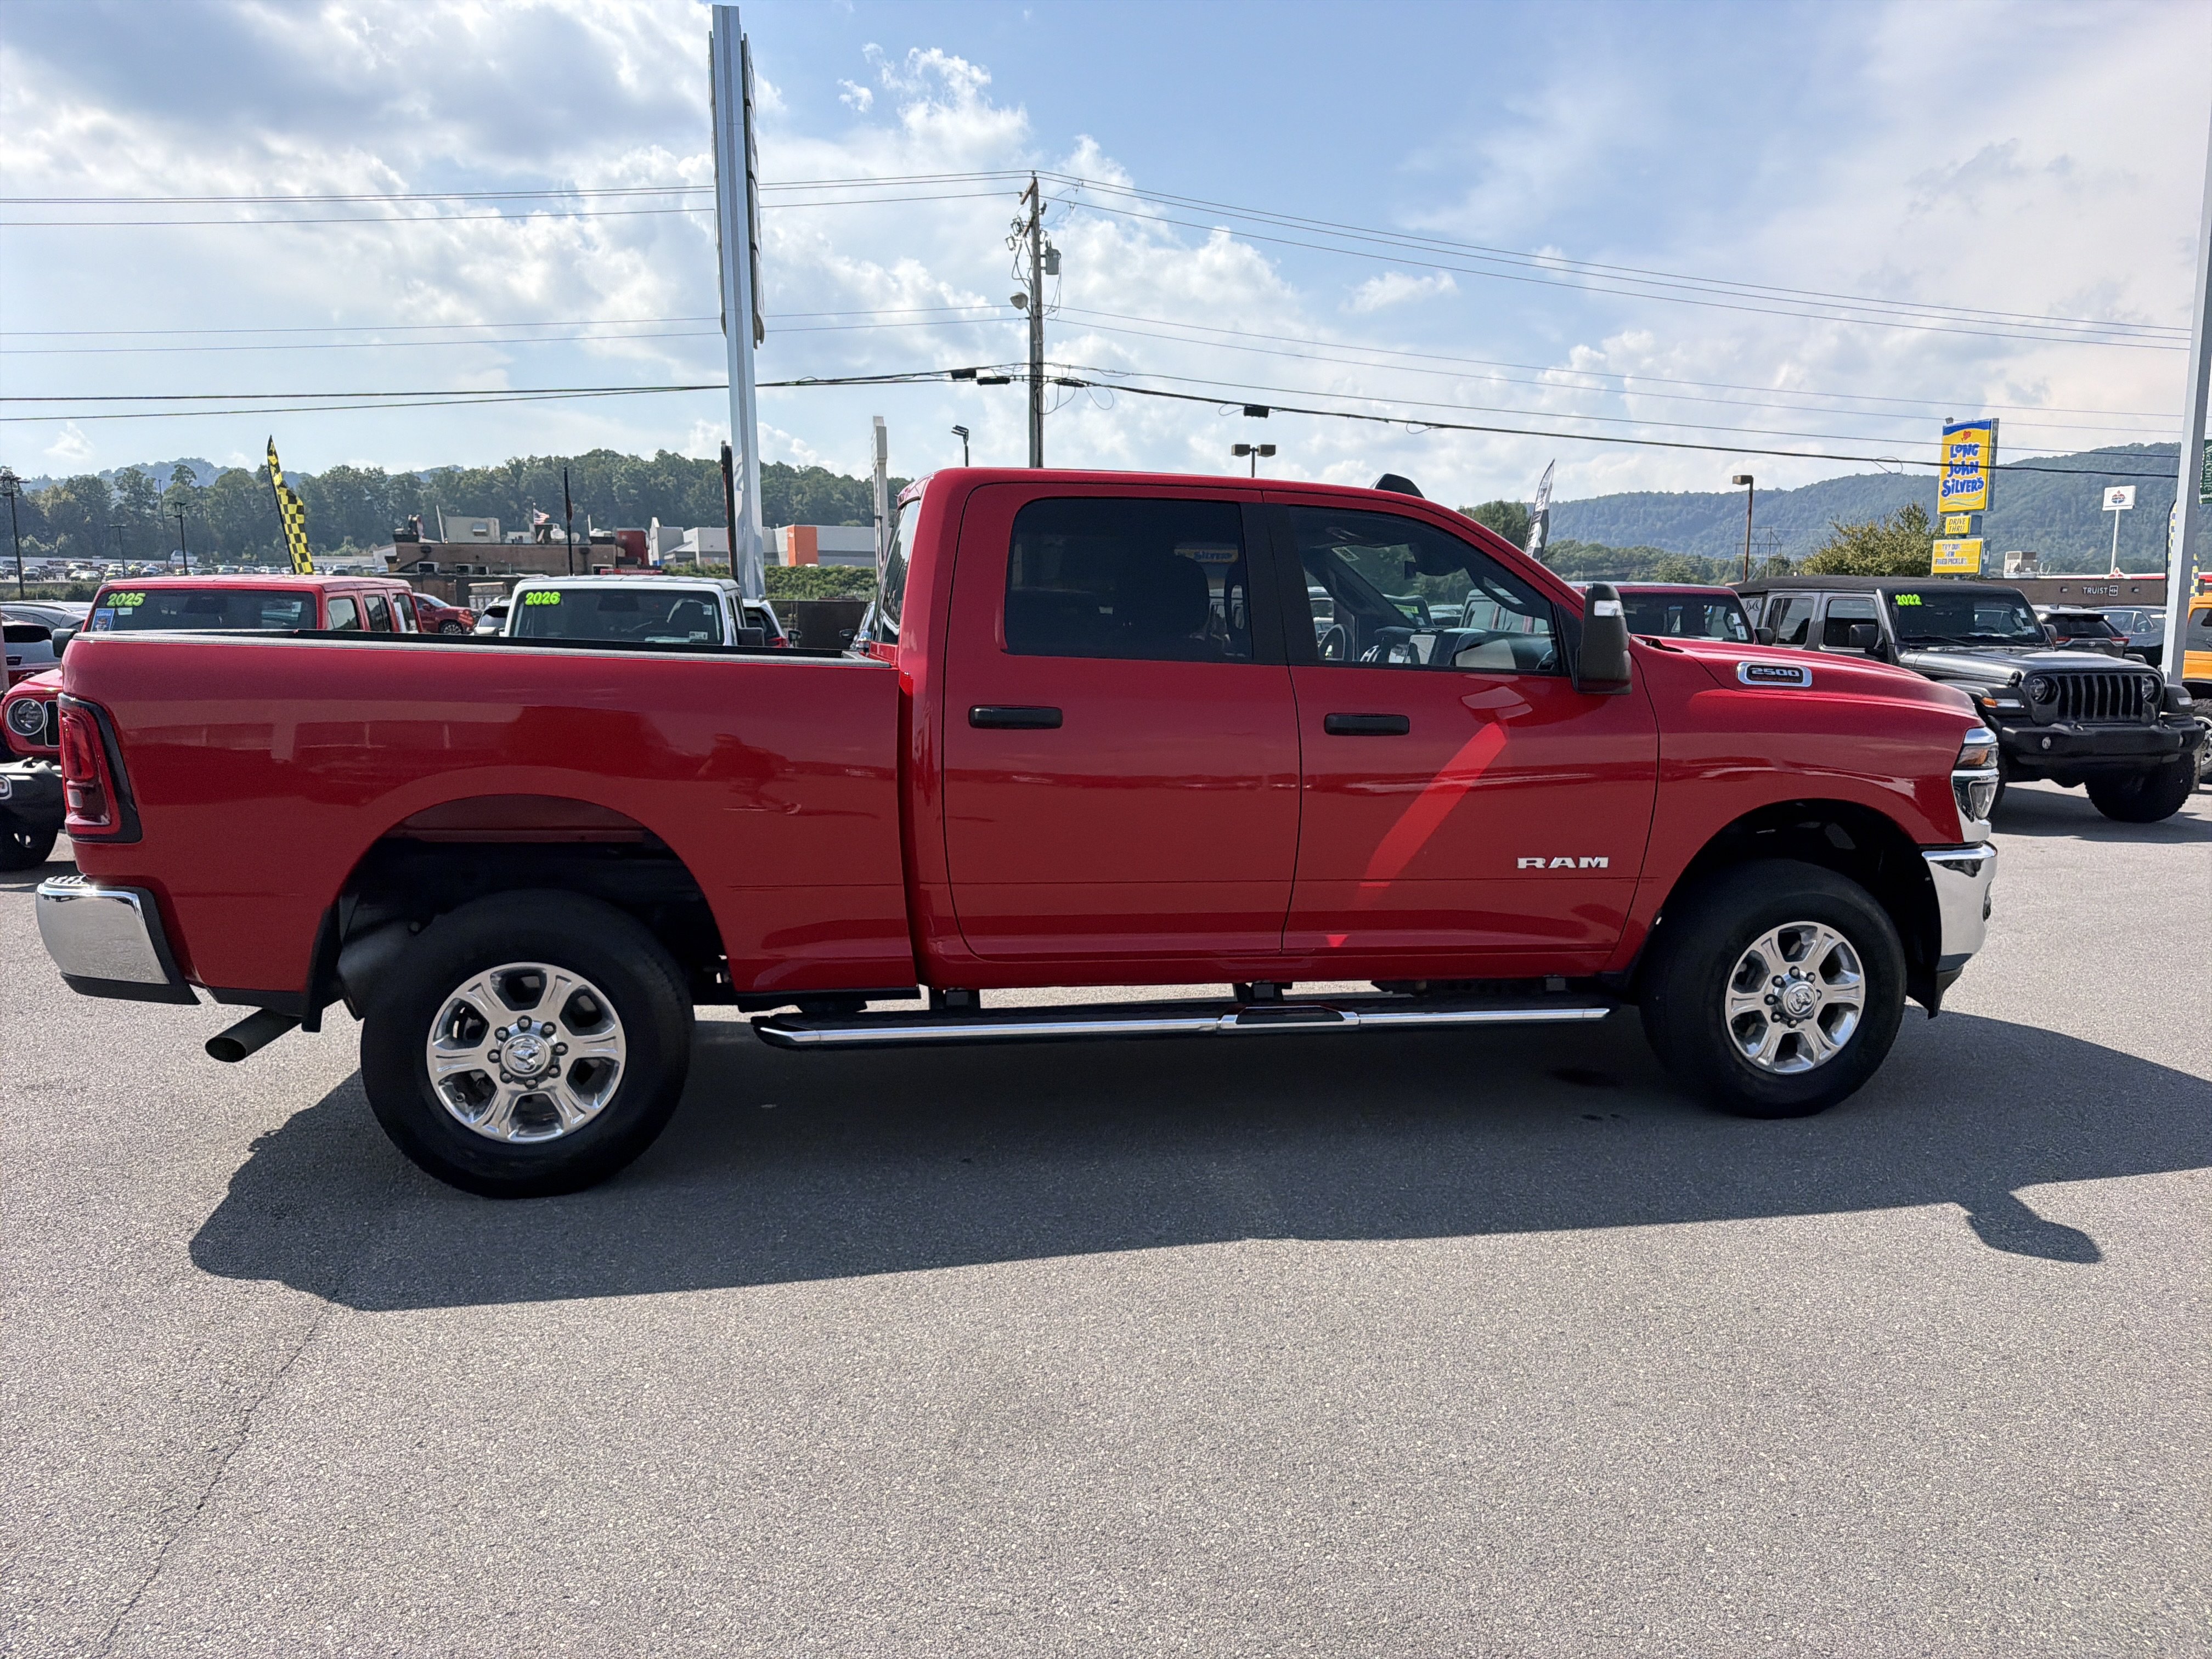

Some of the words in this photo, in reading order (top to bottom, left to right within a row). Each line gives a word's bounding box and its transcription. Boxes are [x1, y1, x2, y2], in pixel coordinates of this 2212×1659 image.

[106, 593, 145, 606] 2025
[525, 591, 561, 605] 2026
[1895, 594, 1922, 606] 2022
[1750, 668, 1800, 677] 2500
[1517, 857, 1609, 868] RAM
